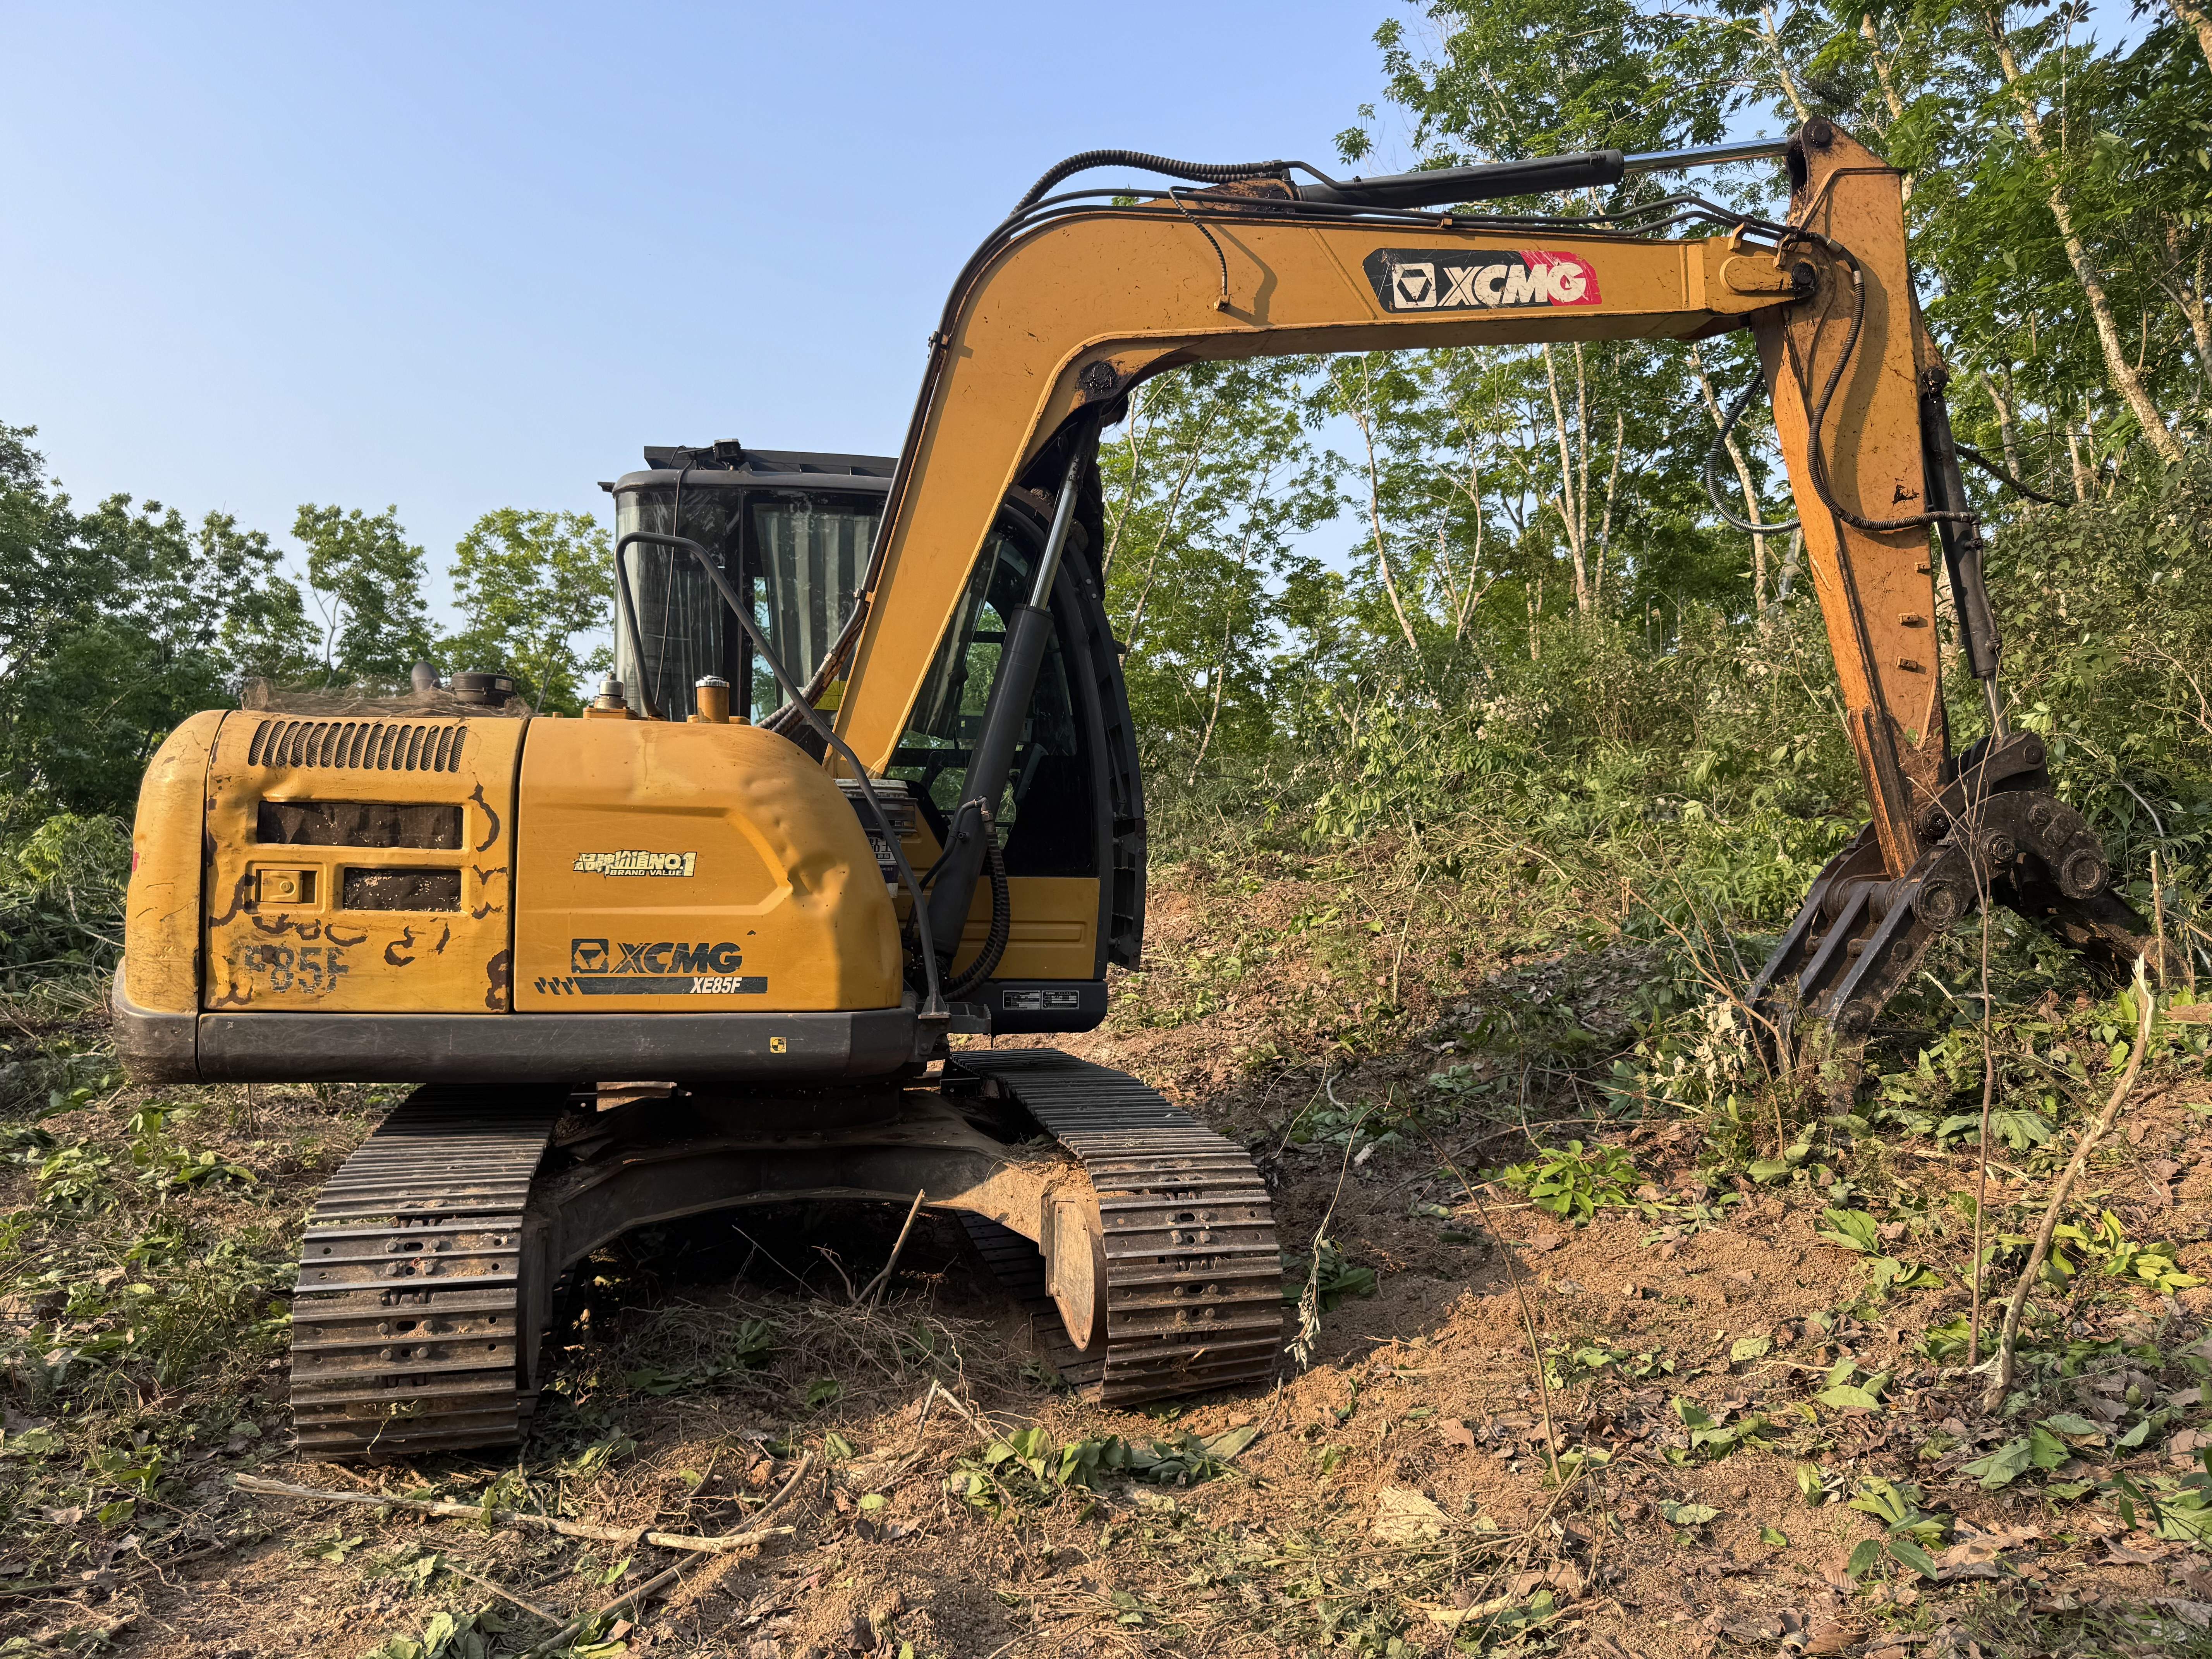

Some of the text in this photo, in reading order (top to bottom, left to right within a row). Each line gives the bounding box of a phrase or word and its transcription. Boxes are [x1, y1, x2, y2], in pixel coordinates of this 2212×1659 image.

[1437, 262, 1586, 306] XCMG
[610, 942, 743, 974] XCMG
[690, 977, 742, 993] XE85F
